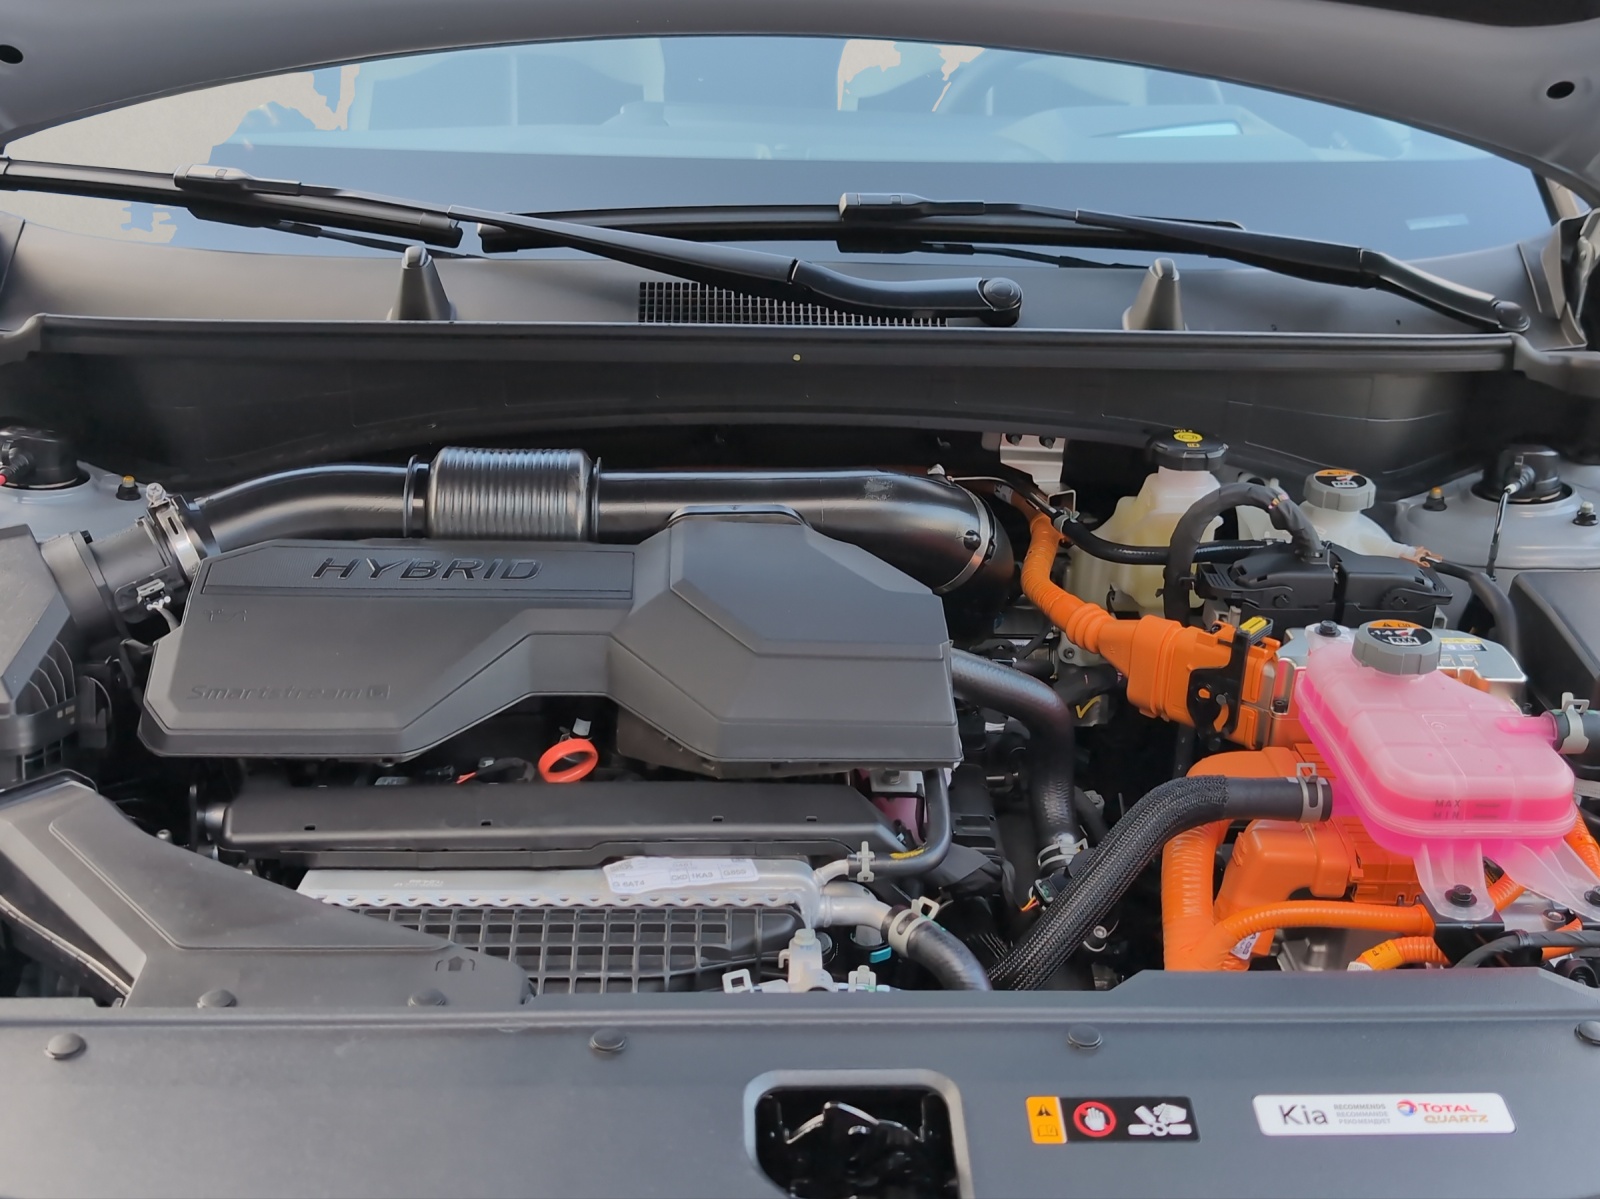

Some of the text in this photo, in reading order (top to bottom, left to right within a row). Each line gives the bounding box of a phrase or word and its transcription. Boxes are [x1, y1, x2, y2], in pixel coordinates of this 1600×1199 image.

[311, 557, 543, 581] HYBRID
[187, 685, 363, 700] Smartstream
[1434, 800, 1461, 808] MAX
[1433, 811, 1460, 820] MIN
[1418, 1102, 1478, 1113] TOTAL
[1278, 1104, 1329, 1125] Kia
[1424, 1114, 1489, 1124] QUARTZ
